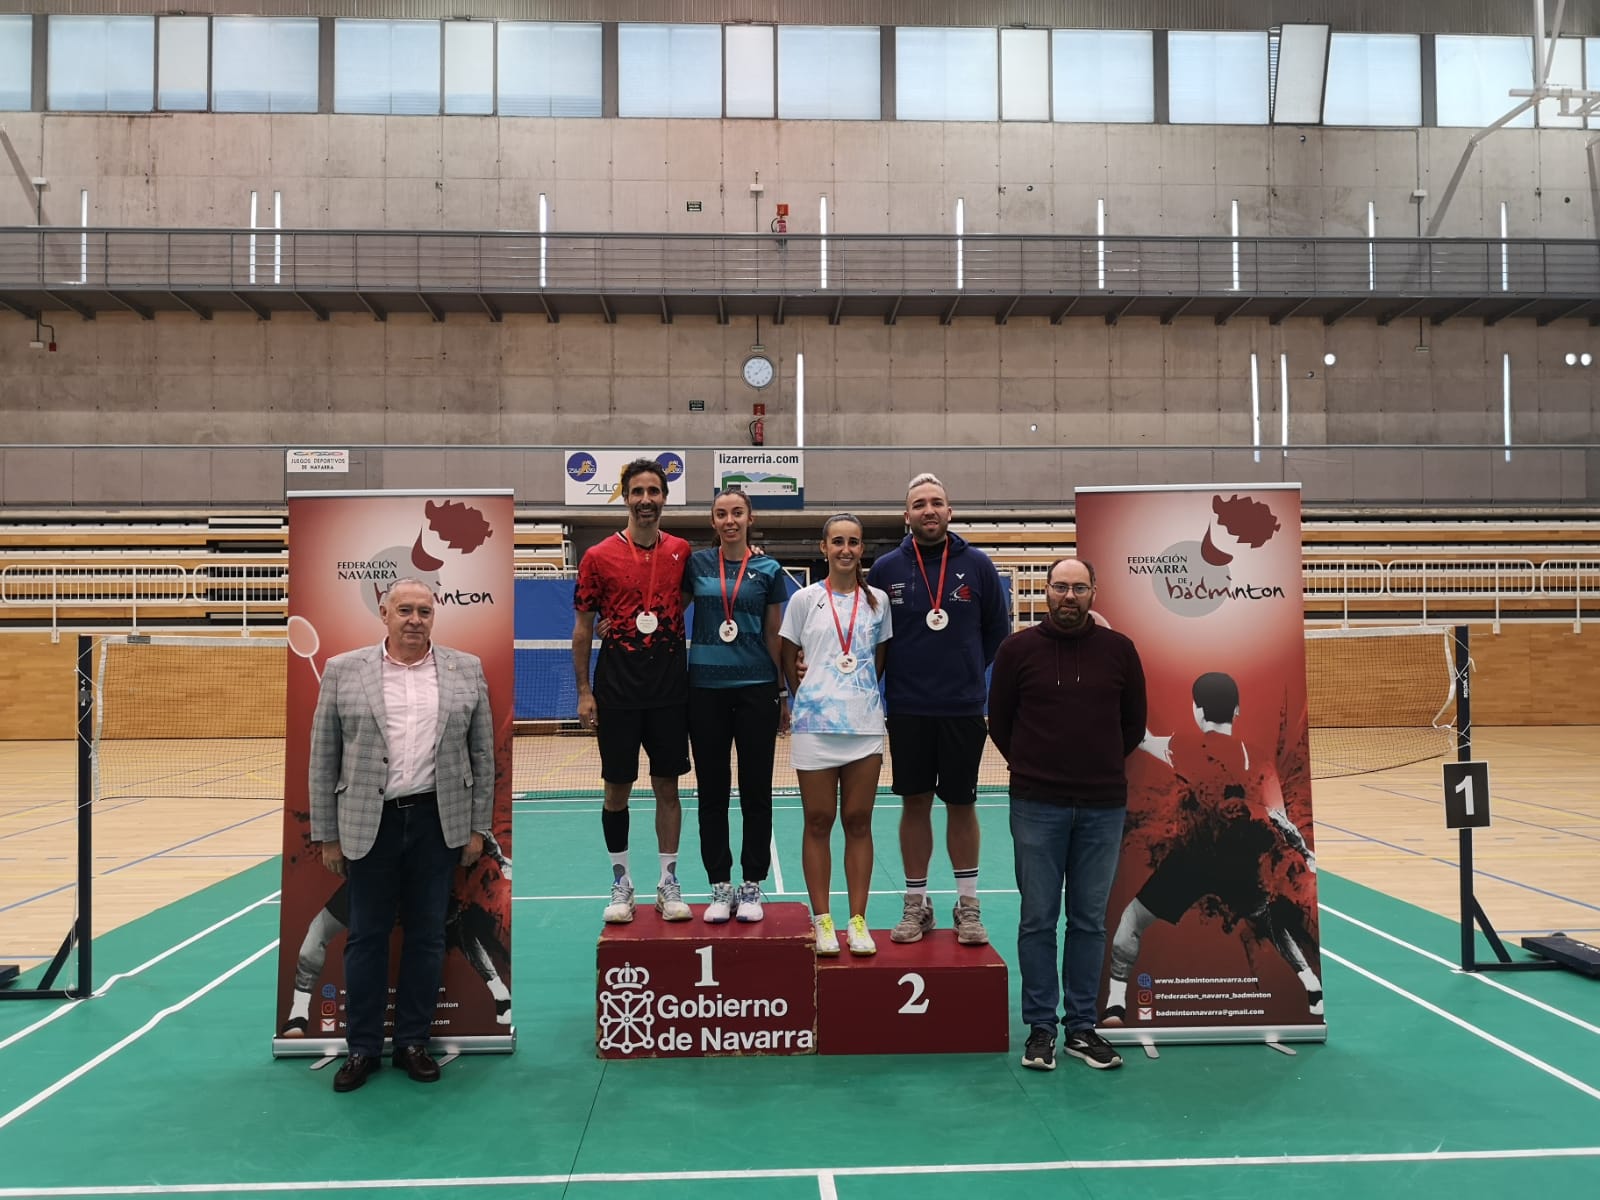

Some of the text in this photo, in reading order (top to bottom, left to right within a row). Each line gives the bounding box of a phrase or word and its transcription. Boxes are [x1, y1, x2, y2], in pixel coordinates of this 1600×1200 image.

[719, 453, 799, 464] lizarrerria.com
[1127, 554, 1187, 564] FEDERACIÓN
[337, 560, 397, 569] FEDERACIÓN
[338, 570, 397, 580] NAVARRA
[1129, 565, 1188, 575] NAVARRA
[1455, 775, 1475, 816] 1
[693, 945, 720, 987] 1
[1155, 976, 1258, 984] www.badmintonnavarra.com
[897, 972, 930, 1014] 2
[1155, 992, 1271, 1000] @federacion_navarra_badminton
[657, 994, 788, 1019] Gobierno
[1155, 1008, 1265, 1017] badmintonnavarra@gmail.com
[657, 1026, 813, 1051] de Navarra
